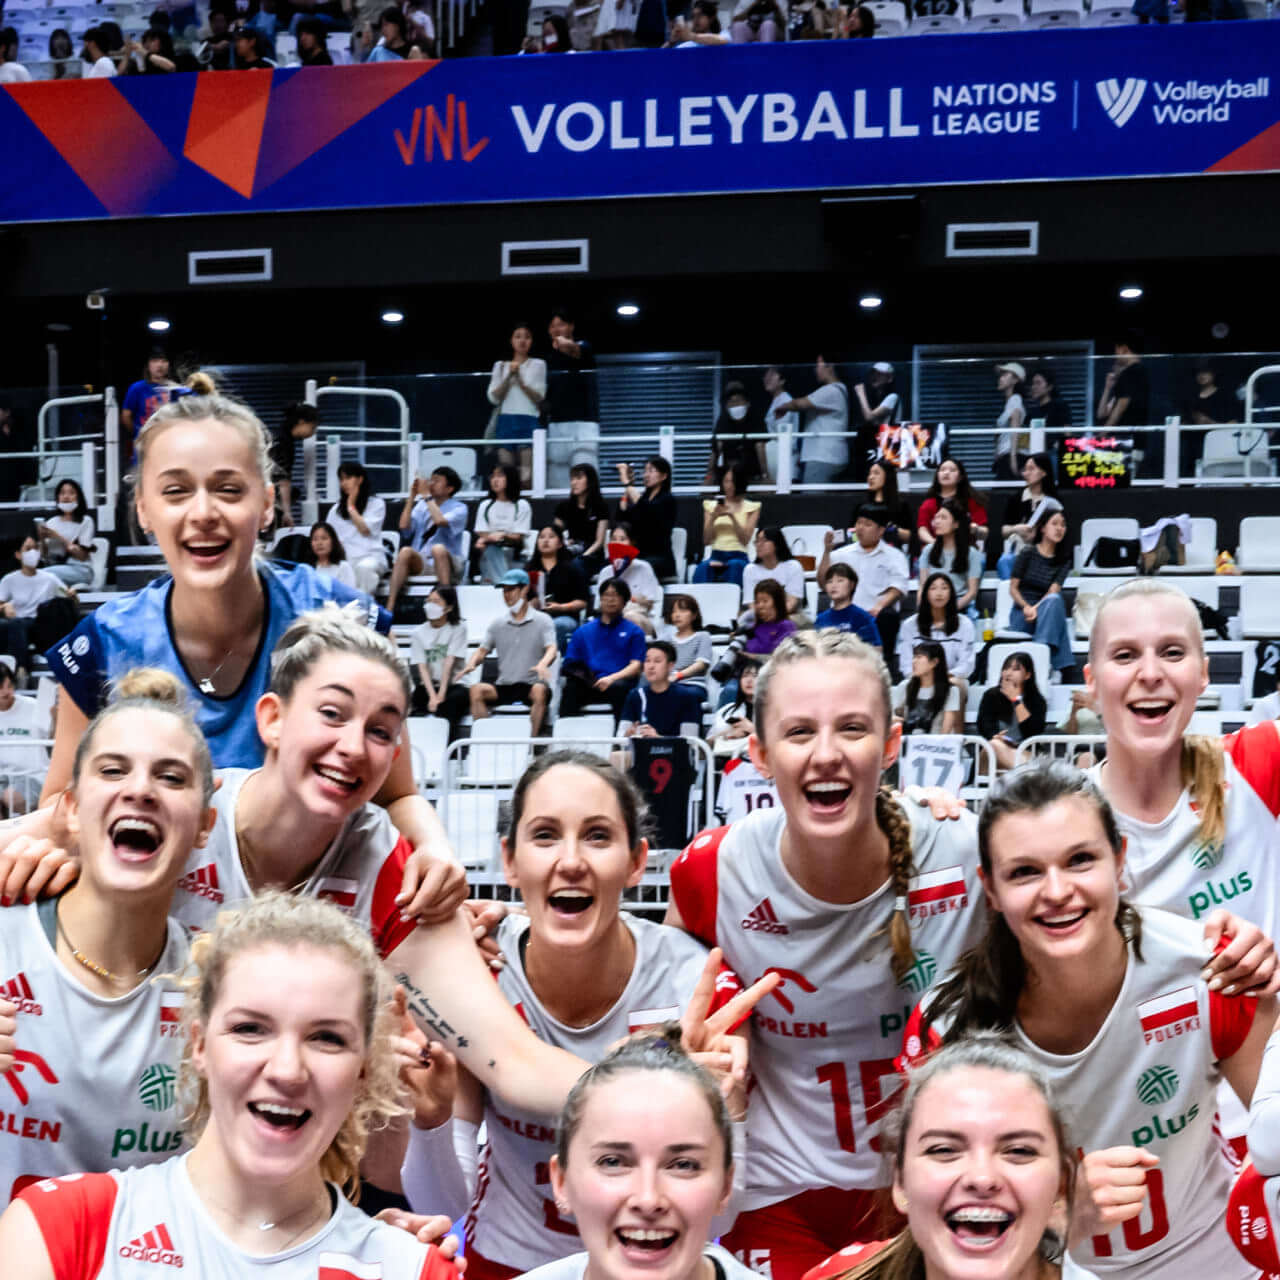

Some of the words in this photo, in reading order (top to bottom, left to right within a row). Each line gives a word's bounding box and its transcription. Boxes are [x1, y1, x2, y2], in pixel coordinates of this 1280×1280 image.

[932, 81, 1058, 108] NATIONS
[1153, 76, 1270, 102] Volleyball
[511, 86, 920, 154] VOLLEYBALL
[931, 109, 1041, 136] LEAGUE
[1153, 99, 1230, 124] World
[648, 757, 673, 795] 9
[911, 756, 955, 788] 17
[908, 895, 969, 921] POLSKA
[1188, 866, 1255, 920] plus
[880, 1003, 910, 1038] pl
[111, 1122, 185, 1158] plus
[498, 1113, 557, 1144] RLEN
[1130, 1102, 1201, 1149] plus
[1237, 1204, 1251, 1247] plus
[118, 1244, 185, 1269] adidas
